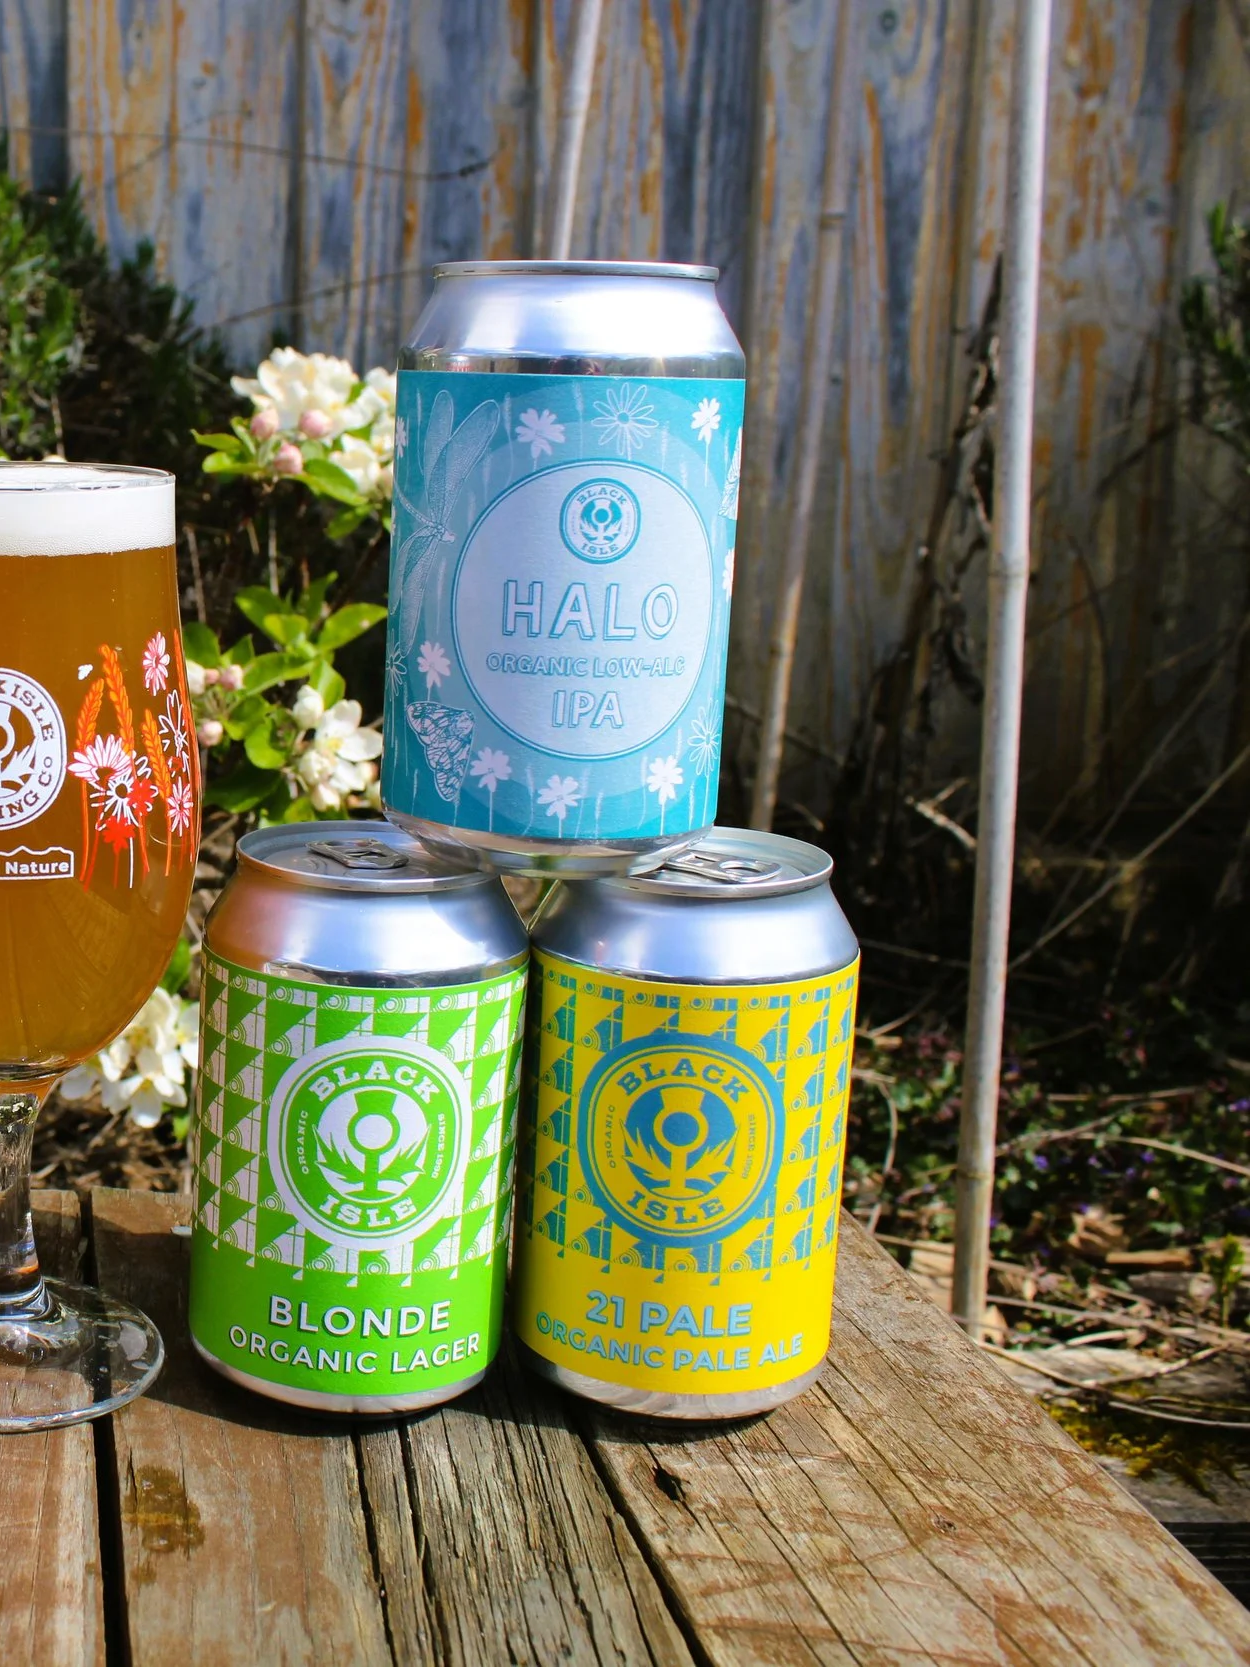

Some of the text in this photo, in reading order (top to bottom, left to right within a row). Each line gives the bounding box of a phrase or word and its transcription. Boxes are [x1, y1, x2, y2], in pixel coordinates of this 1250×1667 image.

[577, 487, 626, 504] BLACK
[581, 543, 619, 555] ISLE
[501, 579, 679, 641] HALO
[486, 653, 686, 679] ORGANIC LOW-ALC
[10, 680, 56, 742] ISLE
[552, 690, 625, 729] IPA
[5, 858, 70, 875] Nature
[308, 1060, 441, 1104] BLACK
[617, 1058, 751, 1103] BLACK
[298, 1110, 309, 1176] ORGANIC
[605, 1104, 616, 1169] ORGANIC
[318, 1195, 417, 1227] ISLE
[626, 1191, 726, 1225] ISLE
[269, 1295, 452, 1338] BLONDE
[585, 1290, 753, 1338] 21 PALE
[229, 1326, 480, 1375] ORGANIC LAGER
[536, 1311, 804, 1373] ORGANIC PALE ALE
